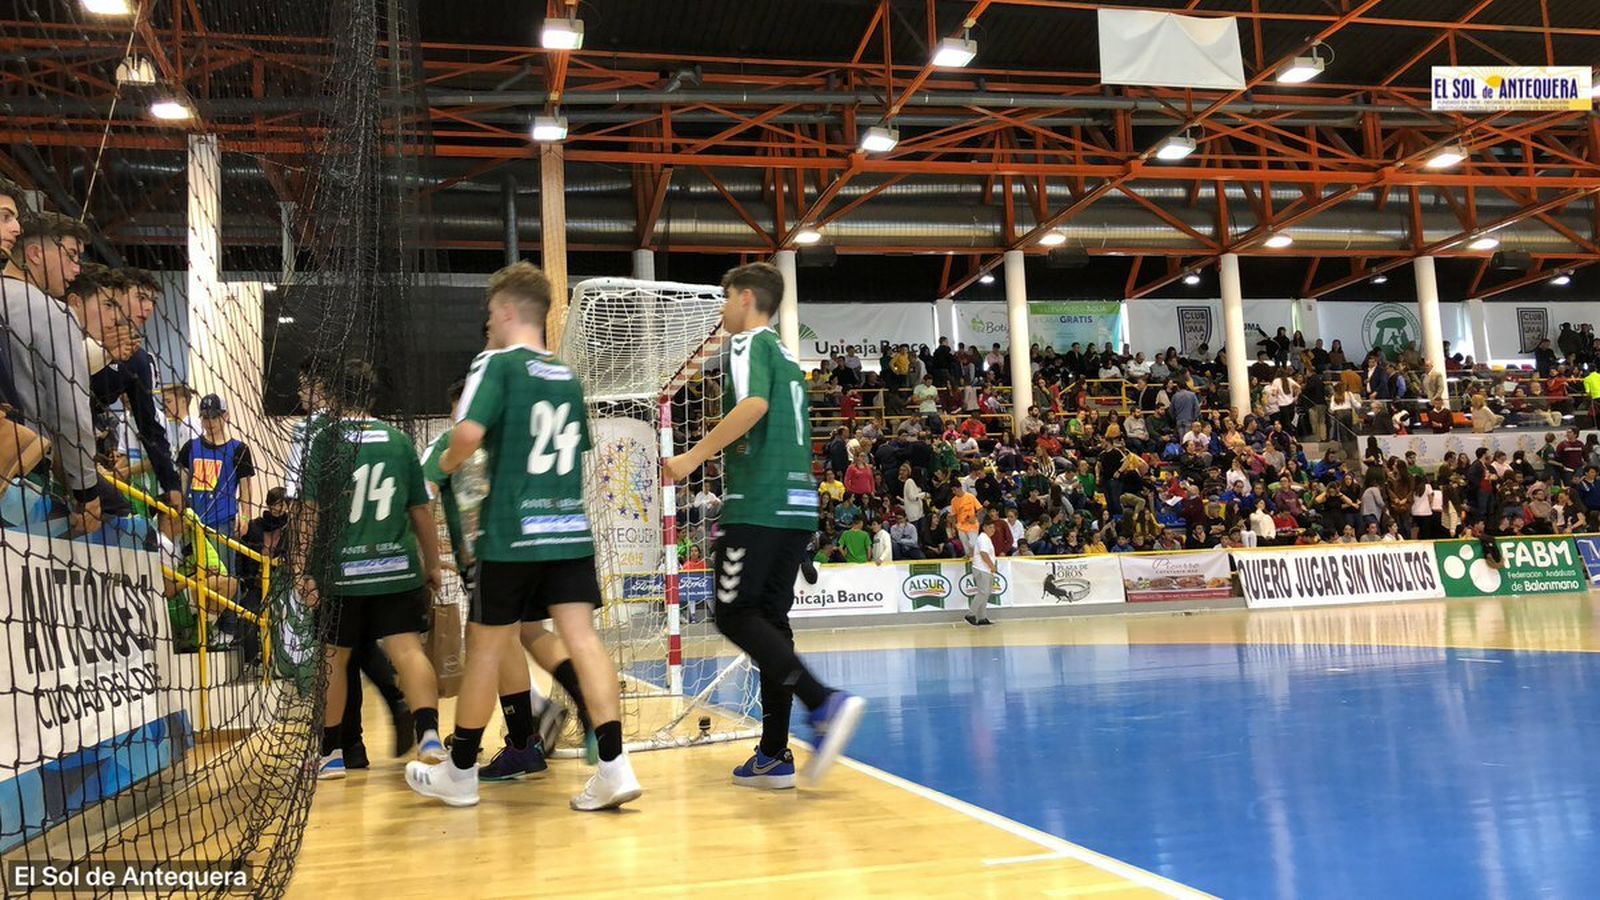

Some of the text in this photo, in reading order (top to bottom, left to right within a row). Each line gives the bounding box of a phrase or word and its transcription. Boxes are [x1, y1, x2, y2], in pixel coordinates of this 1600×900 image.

[1059, 315, 1093, 324] GRATIS
[1183, 312, 1206, 320] CLUB
[527, 400, 582, 476] 24
[349, 462, 397, 524] 14
[1500, 540, 1573, 569] FABM
[1295, 555, 1344, 598] JUGAR
[1342, 553, 1370, 595] SIN
[1367, 550, 1437, 593] INSULTOS
[1545, 569, 1576, 577] Andaluza
[679, 576, 708, 589] Ford
[908, 579, 945, 591] ALSUR
[1511, 580, 1579, 591] de Balonmano
[838, 590, 884, 603] Banco
